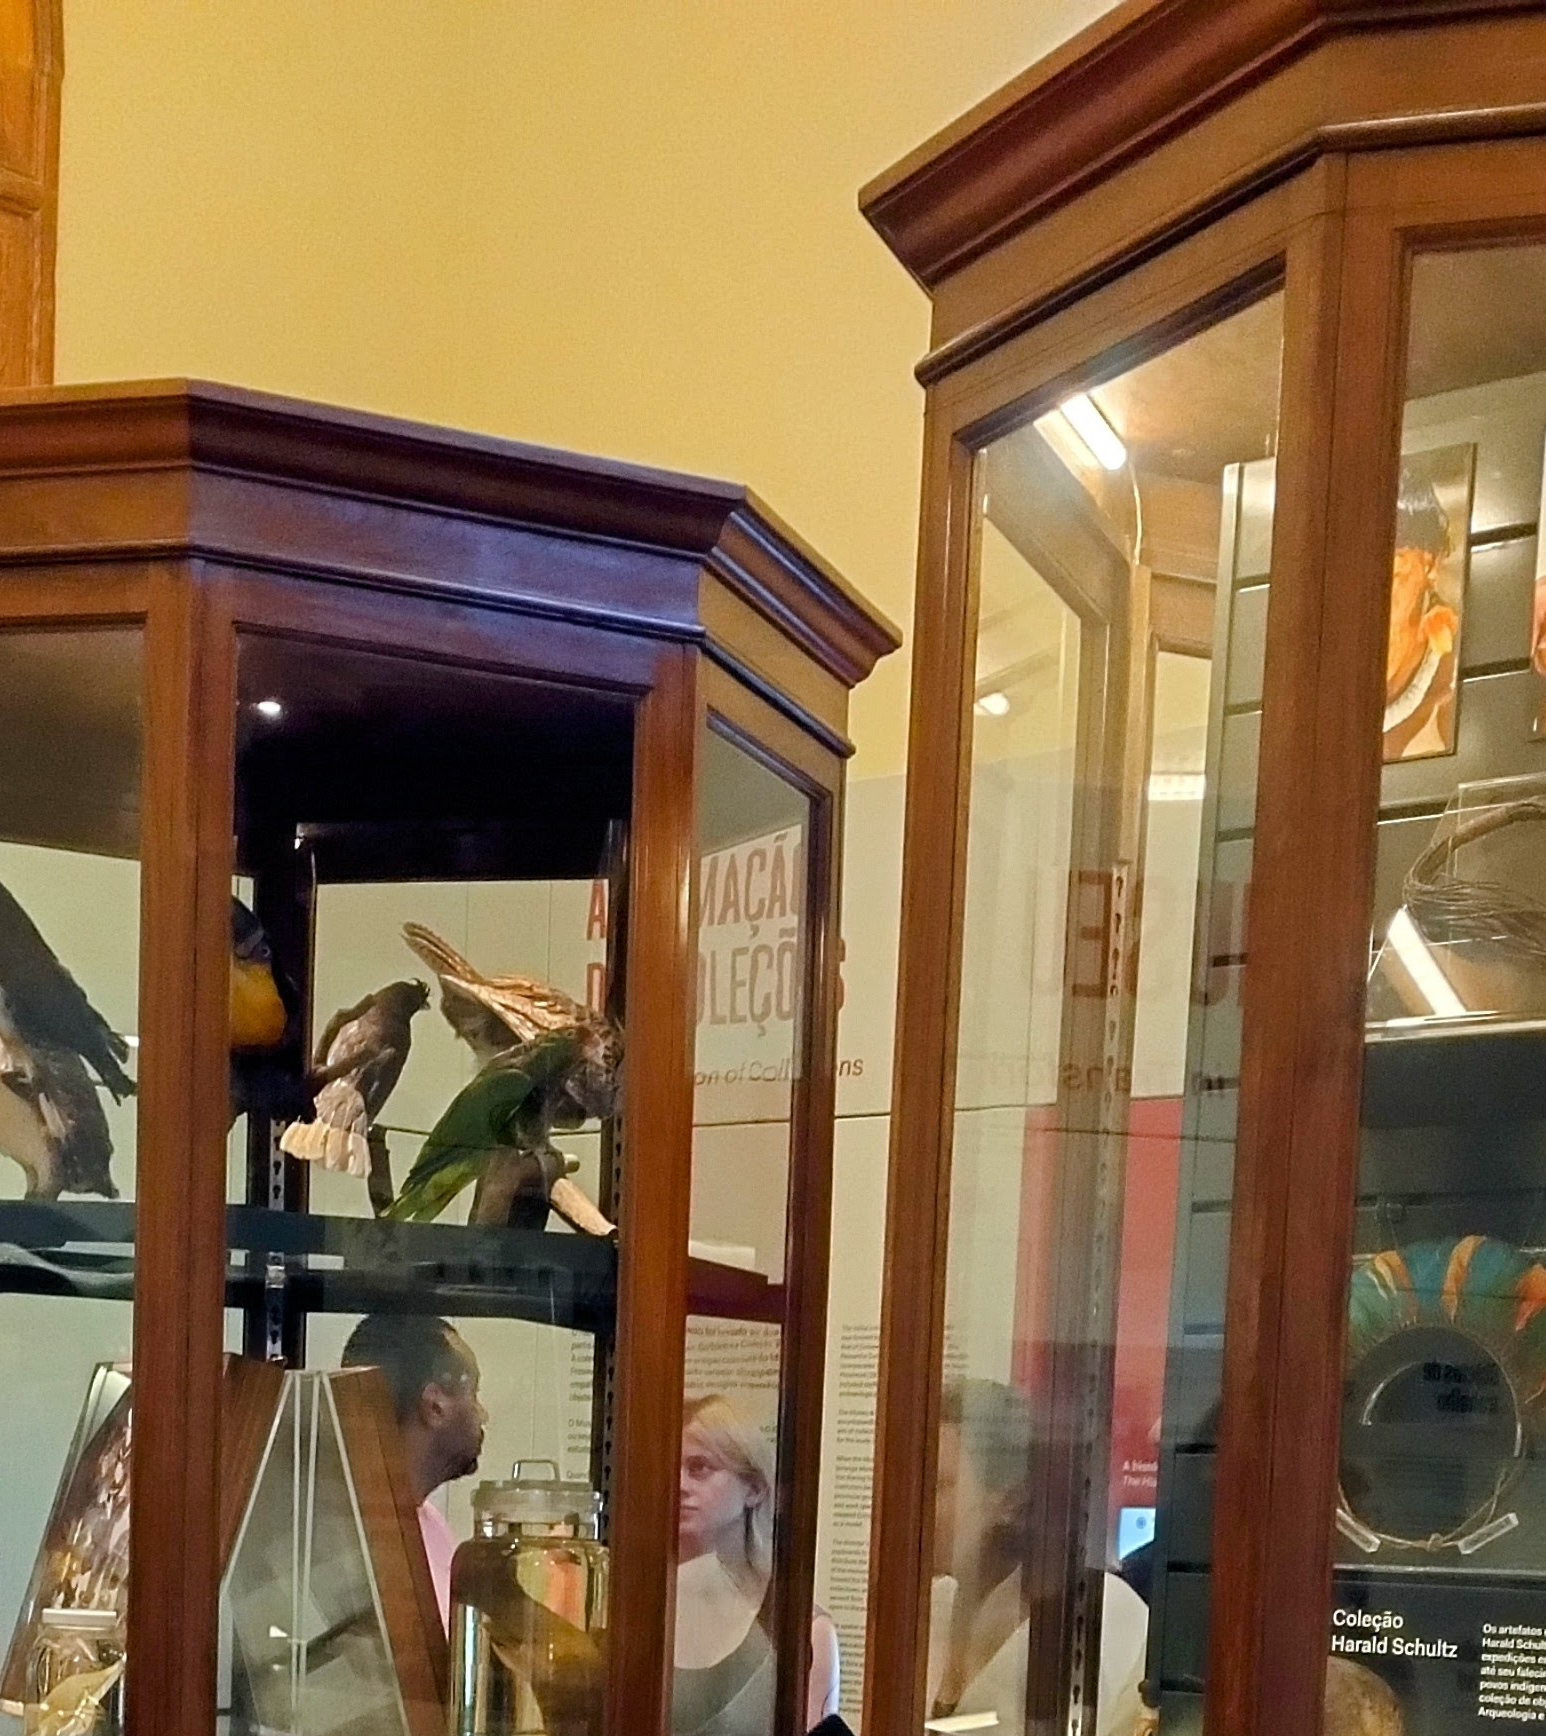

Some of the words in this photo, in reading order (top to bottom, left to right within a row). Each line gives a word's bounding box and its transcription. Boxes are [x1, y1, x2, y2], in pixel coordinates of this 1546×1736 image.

[1332, 1609, 1404, 1633] Coleção
[1483, 1624, 1497, 1634] Os
[1498, 1625, 1542, 1636] artefatos
[1331, 1635, 1388, 1654] Harald
[1392, 1638, 1458, 1658] Schultz
[1481, 1639, 1515, 1649] Harald
[1481, 1652, 1536, 1667] expedições
[1497, 1669, 1515, 1677] seu
[1479, 1682, 1509, 1693] povos
[1478, 1693, 1517, 1707] coleção
[1517, 1696, 1531, 1706] de
[1477, 1707, 1537, 1722] Arqueologia
[1537, 1712, 1545, 1720] e
